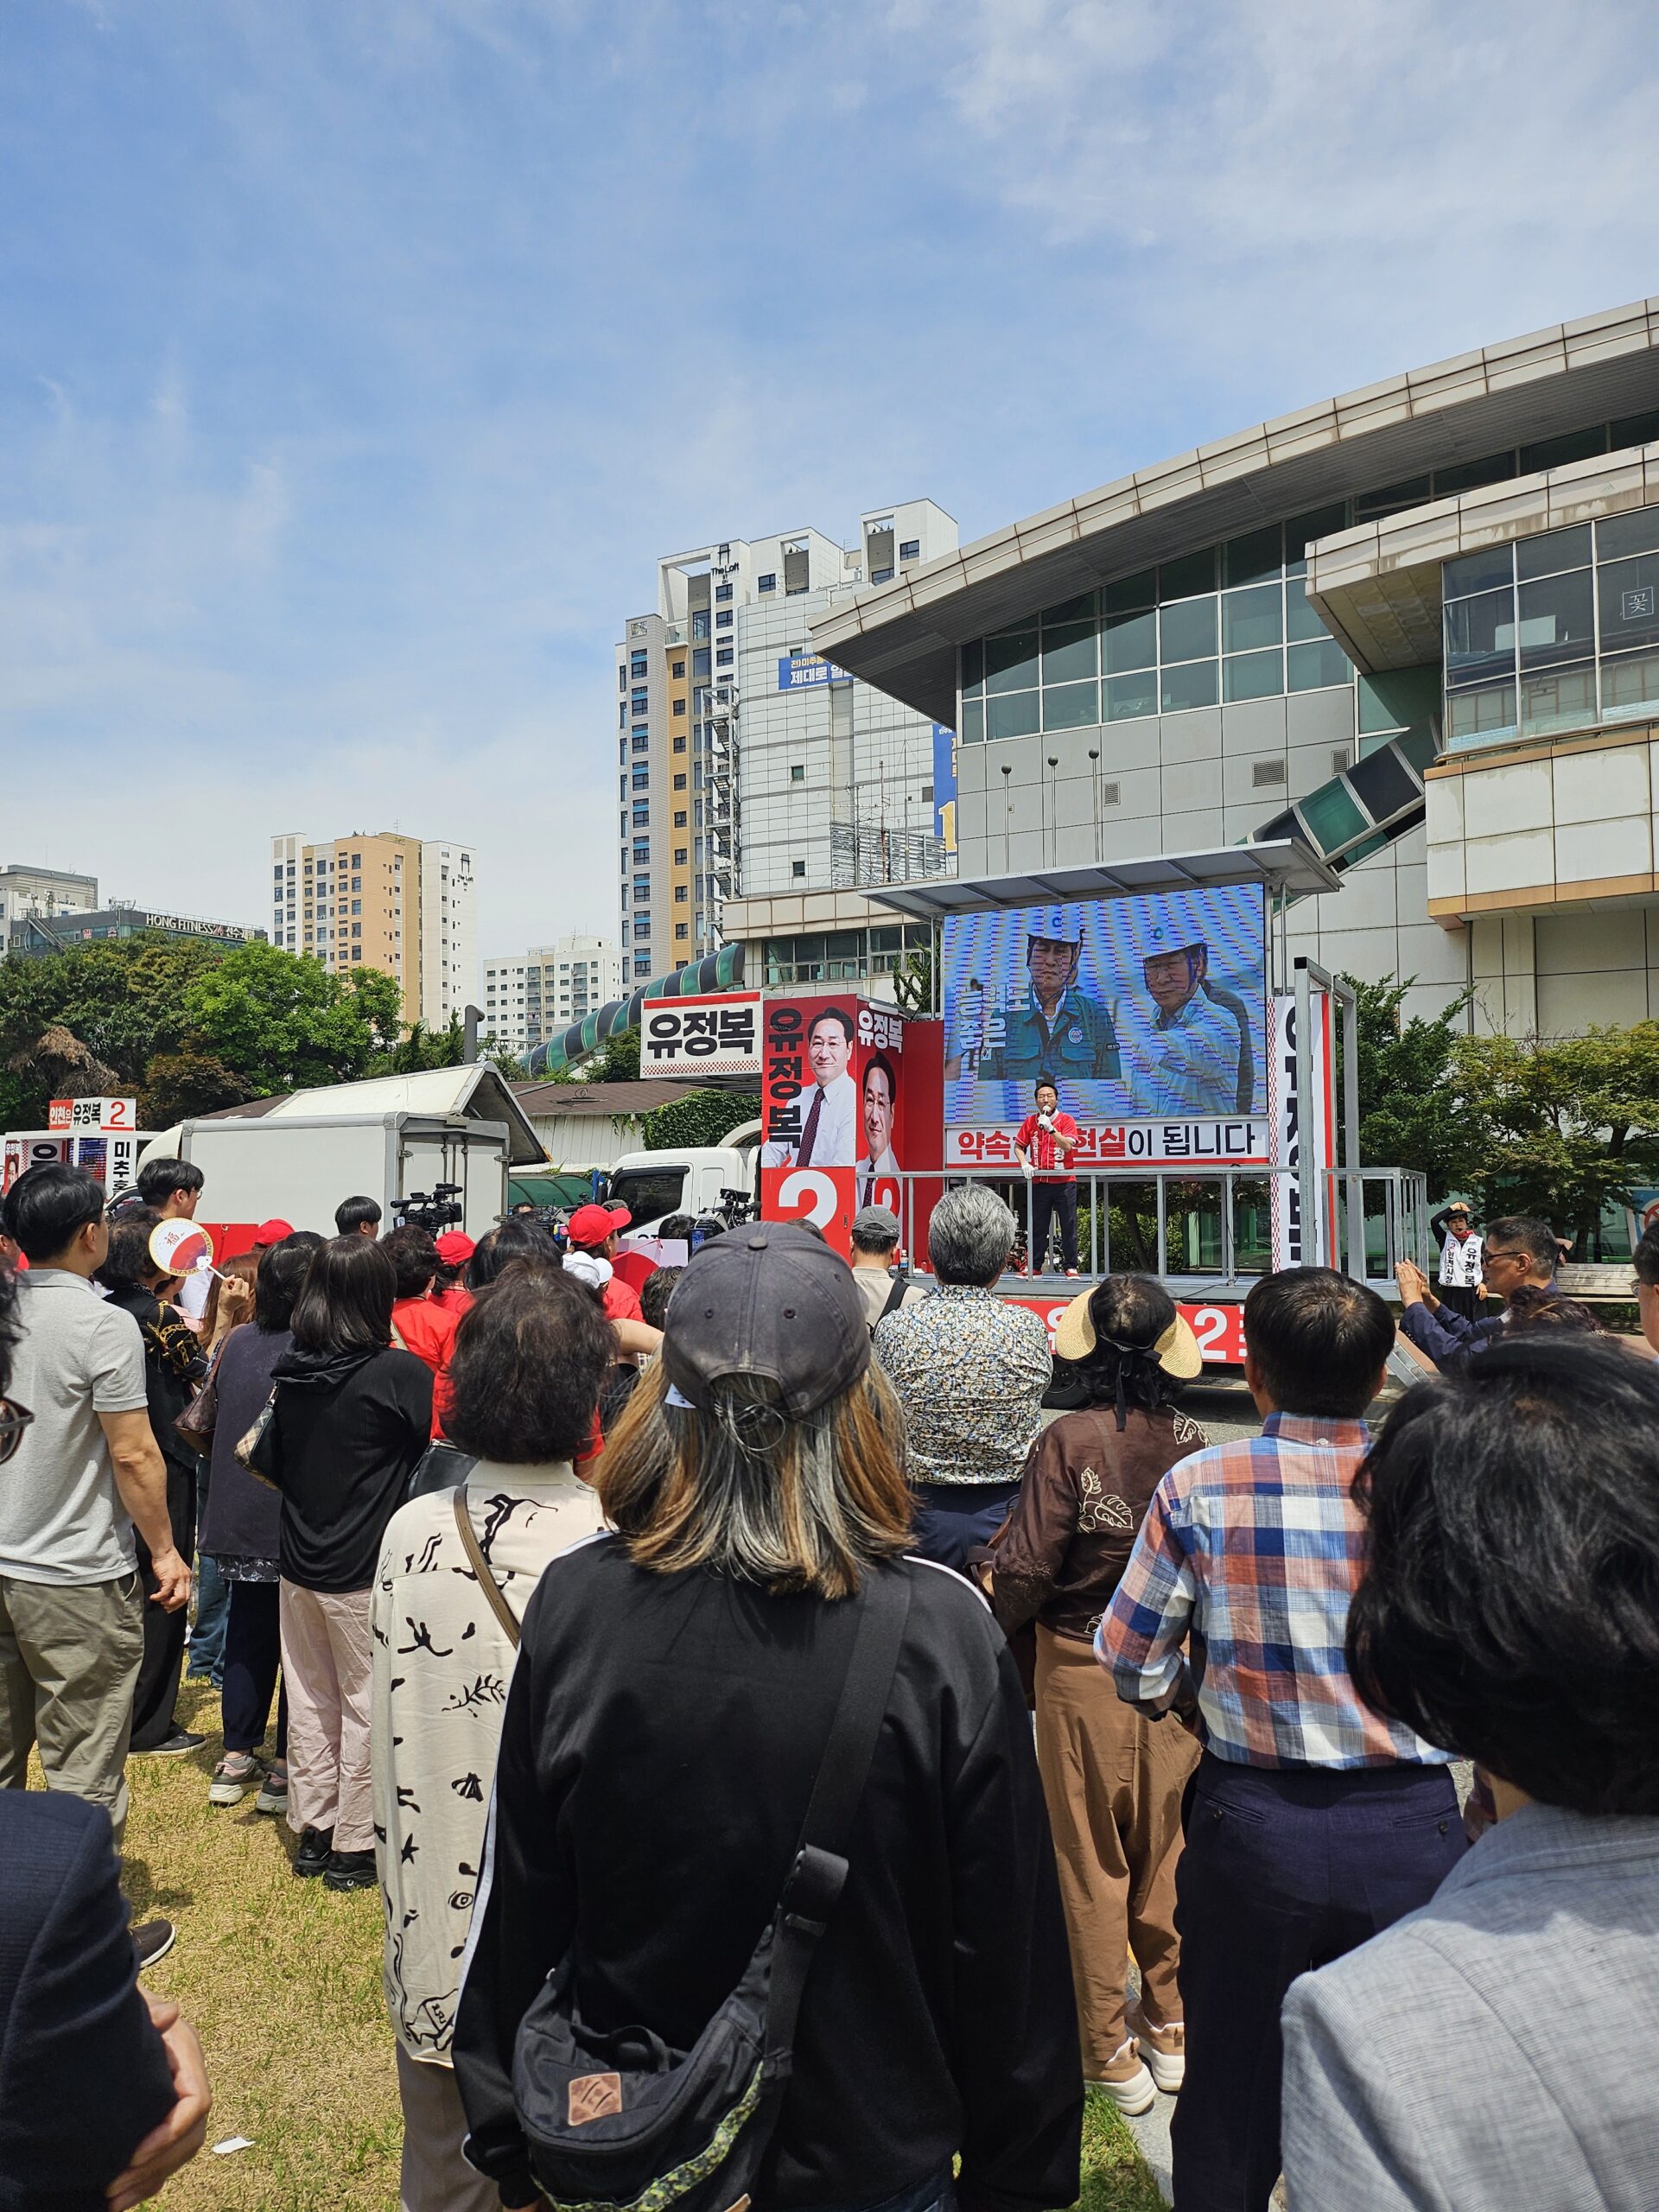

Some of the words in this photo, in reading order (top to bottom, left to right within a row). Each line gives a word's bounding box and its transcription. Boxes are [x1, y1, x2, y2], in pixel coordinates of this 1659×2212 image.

[791, 666, 827, 684] 제대로
[146, 913, 176, 928] HONG
[647, 1008, 755, 1059] 유정복
[858, 1010, 903, 1054] 유정복
[767, 1007, 804, 1149] 유정복
[49, 1105, 72, 1126] 인천은
[73, 1103, 101, 1126] 유정복
[110, 1101, 125, 1125] 2
[958, 1129, 1017, 1160] 약속
[1162, 1123, 1255, 1157] 됩니다
[1464, 1248, 1477, 1287] 유정복
[1194, 1308, 1227, 1360] 2
